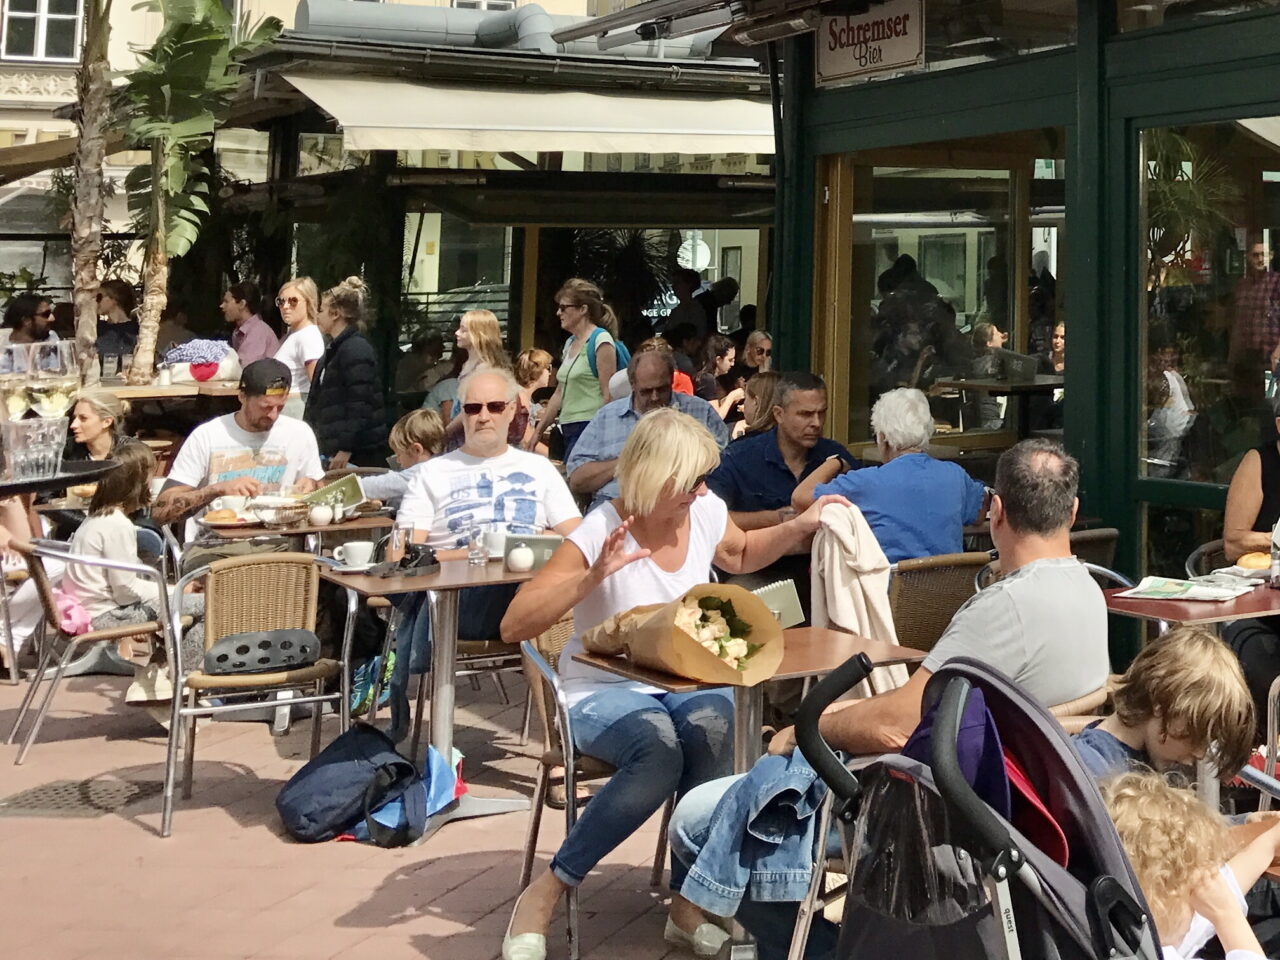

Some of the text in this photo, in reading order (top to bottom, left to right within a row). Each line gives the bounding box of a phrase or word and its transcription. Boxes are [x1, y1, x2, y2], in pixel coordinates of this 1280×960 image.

[828, 13, 910, 52] Schremser
[853, 41, 883, 68] Bier
[1003, 908, 1014, 934] quest
